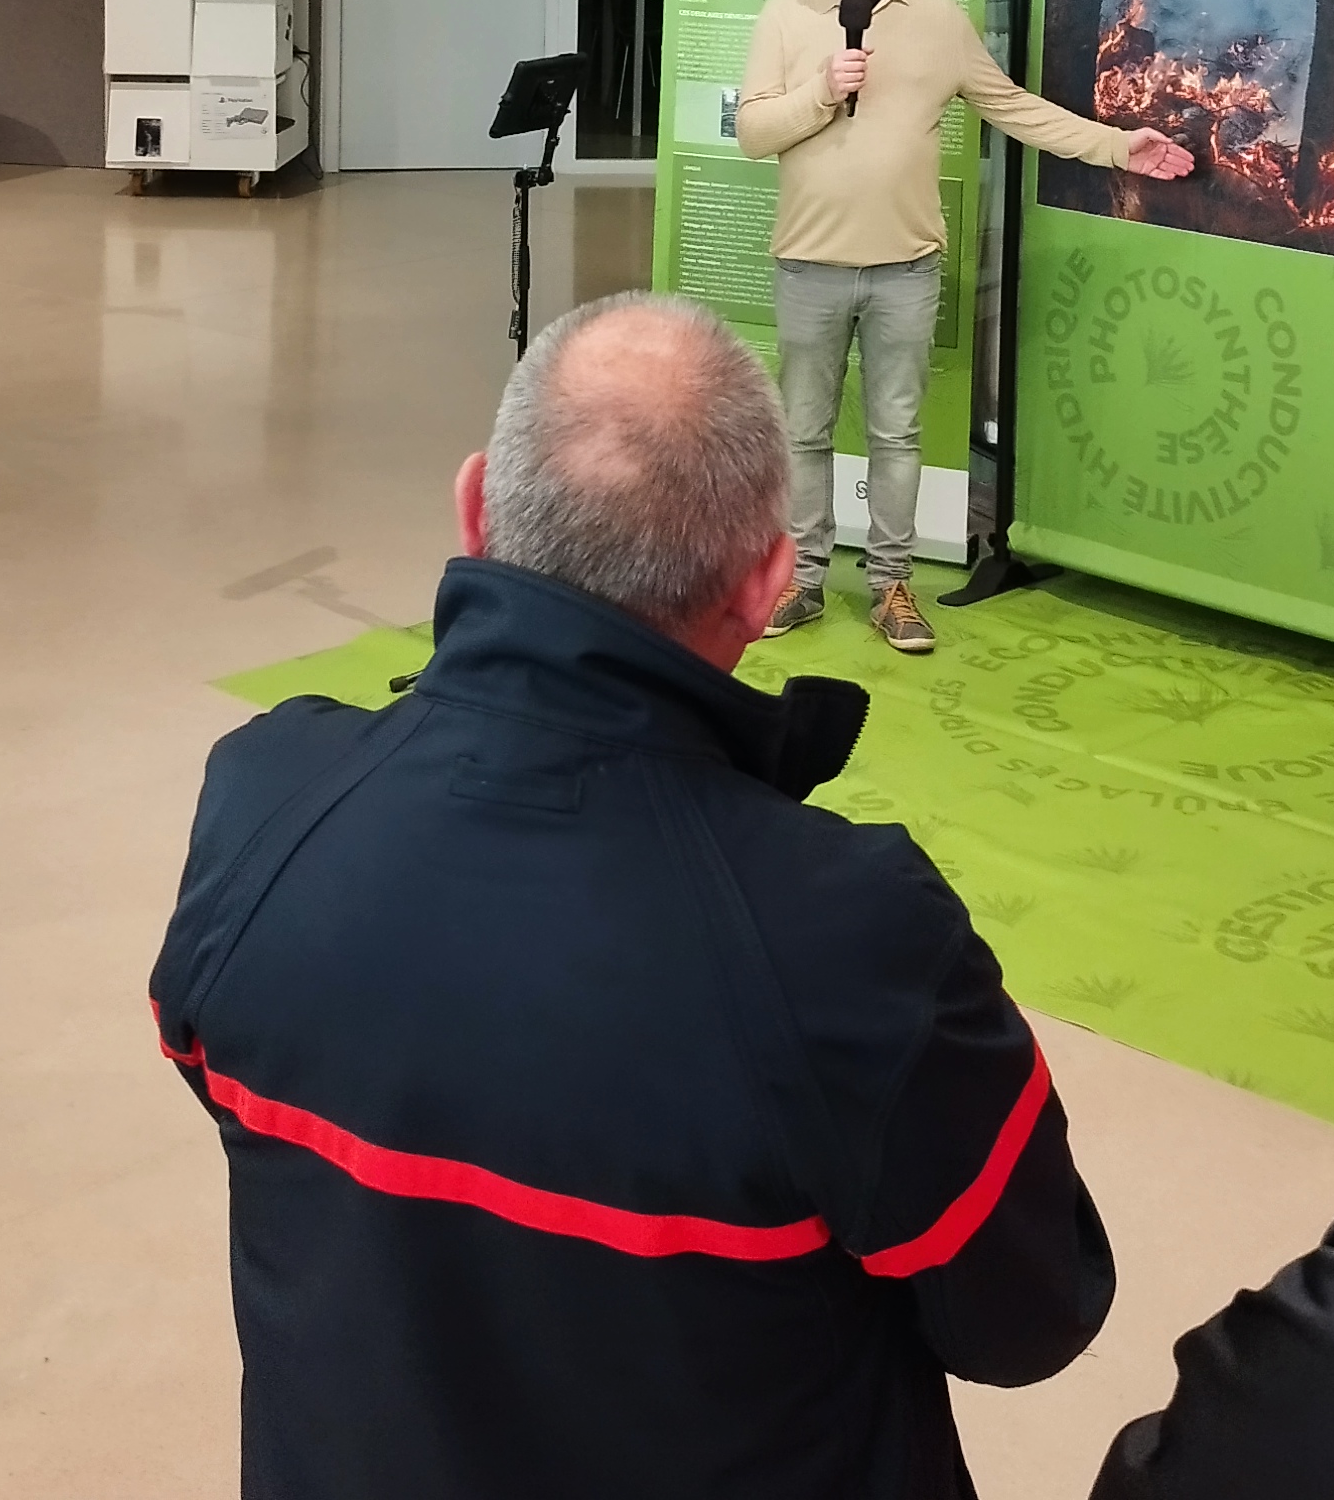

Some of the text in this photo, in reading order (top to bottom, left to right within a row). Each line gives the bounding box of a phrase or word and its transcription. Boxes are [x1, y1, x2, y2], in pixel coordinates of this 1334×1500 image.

[1044, 249, 1302, 525] CONDUCTIVITÉ HYDRIQUE
[1088, 266, 1251, 465] PHOTOSYNTHÈSE
